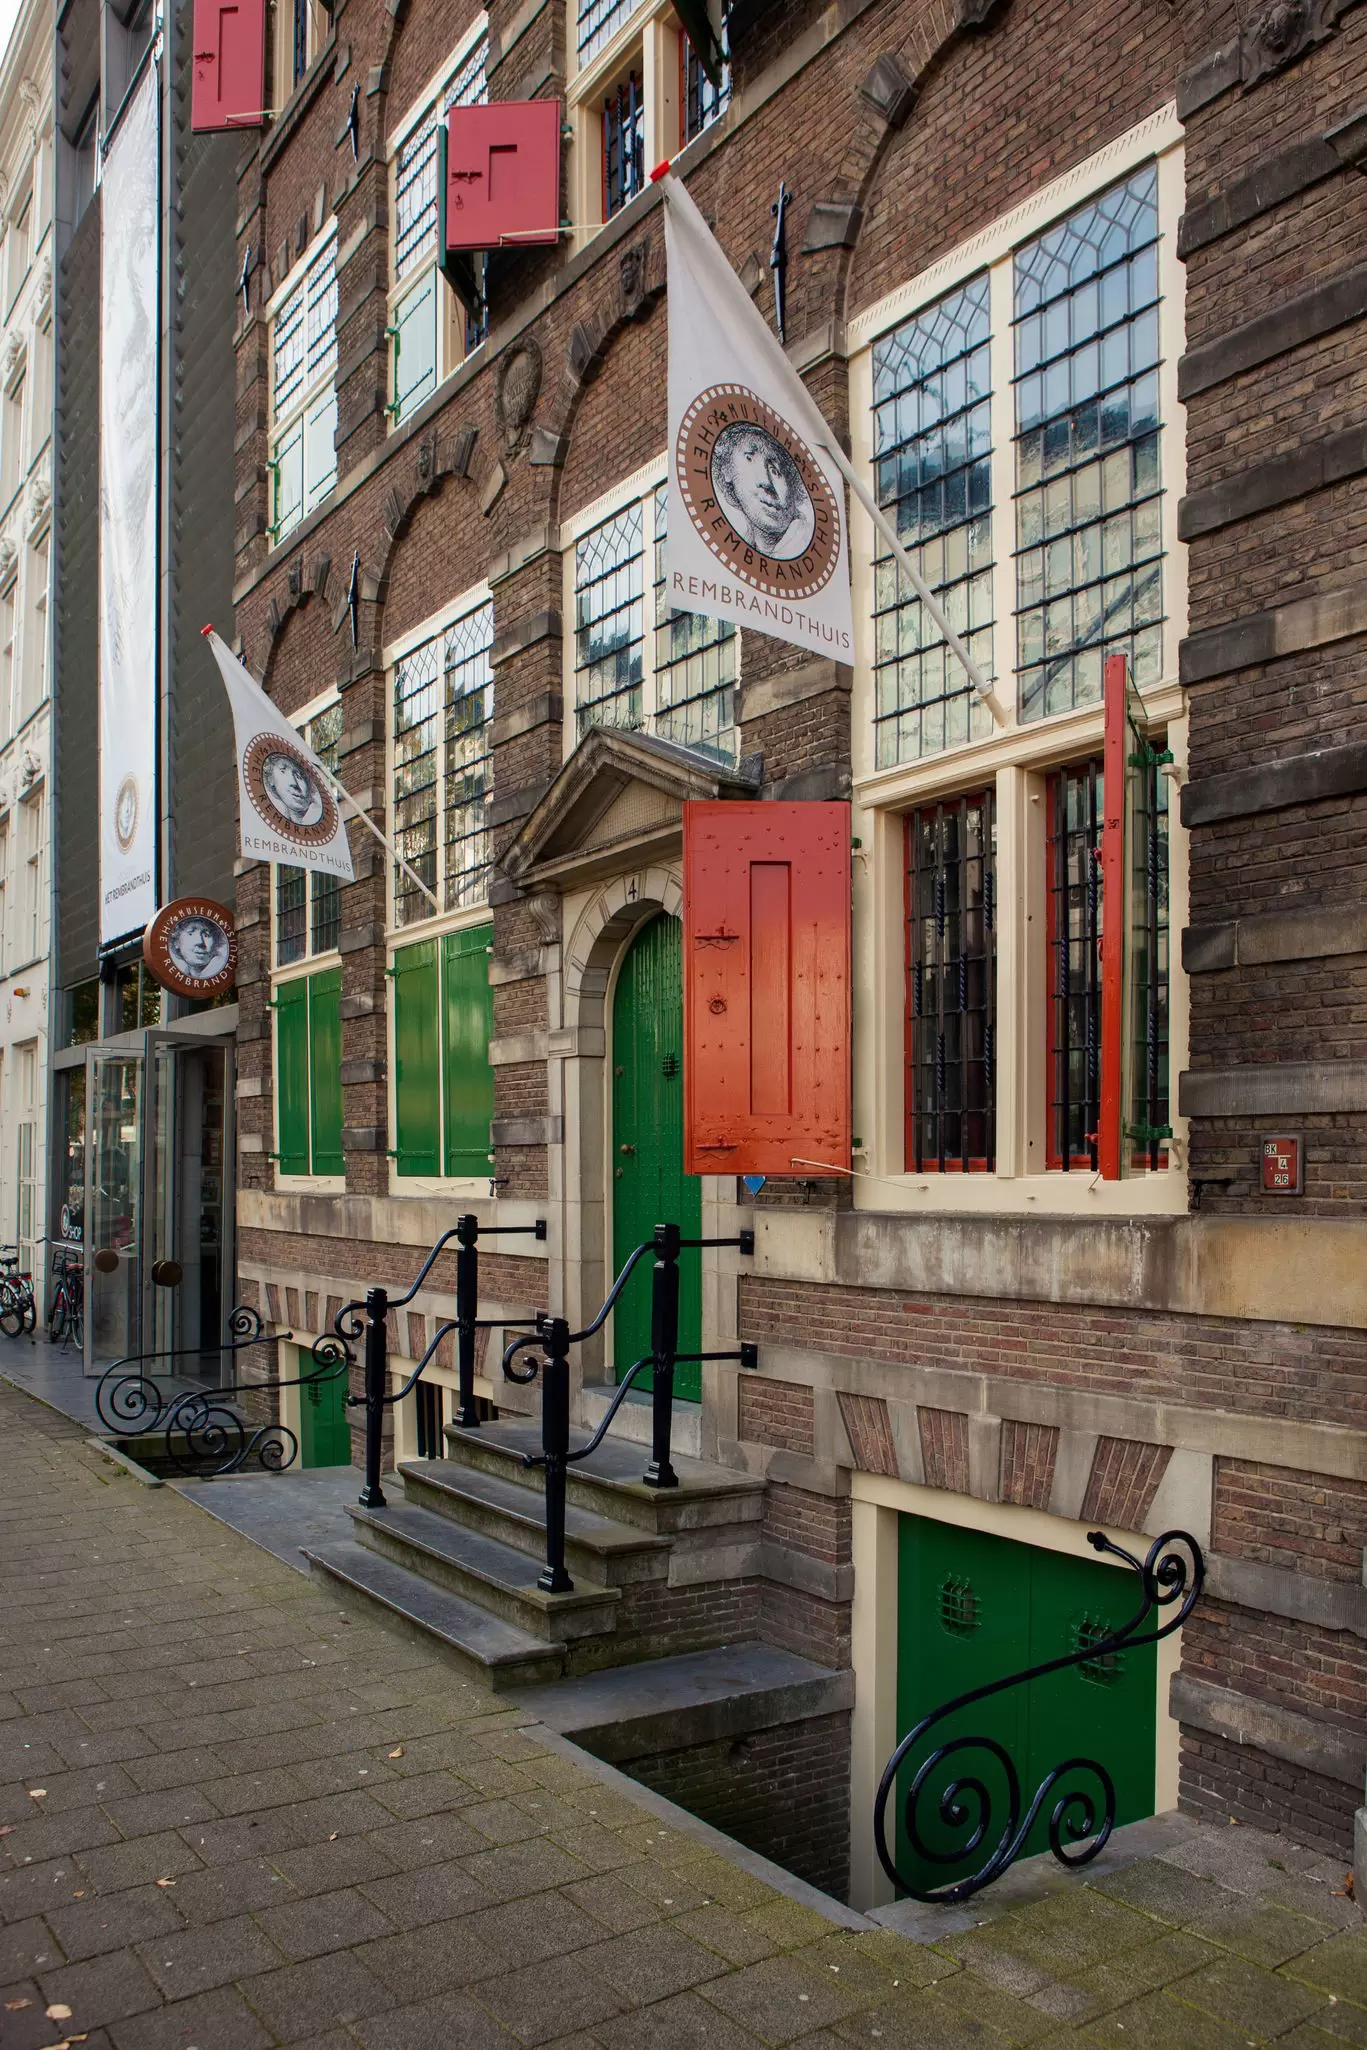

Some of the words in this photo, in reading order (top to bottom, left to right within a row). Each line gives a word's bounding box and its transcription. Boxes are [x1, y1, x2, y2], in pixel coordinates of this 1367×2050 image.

[729, 402, 793, 451] MUSEUM
[693, 425, 715, 481] HET
[700, 482, 829, 581] REMBRANDTHUIS
[672, 571, 850, 649] REMBRANDTHUIS
[259, 783, 332, 836] REMBRANDTHUI
[244, 836, 352, 872] REMBRANDTHUIS
[628, 877, 637, 900] 4
[178, 906, 220, 921] MUSEUM
[160, 925, 171, 952] HET
[163, 931, 238, 988] REMBRANDTHUIS
[1265, 1144, 1277, 1154] BK
[1280, 1159, 1287, 1169] 4
[1275, 1174, 1288, 1185] 26
[69, 1225, 82, 1240] SHOP
